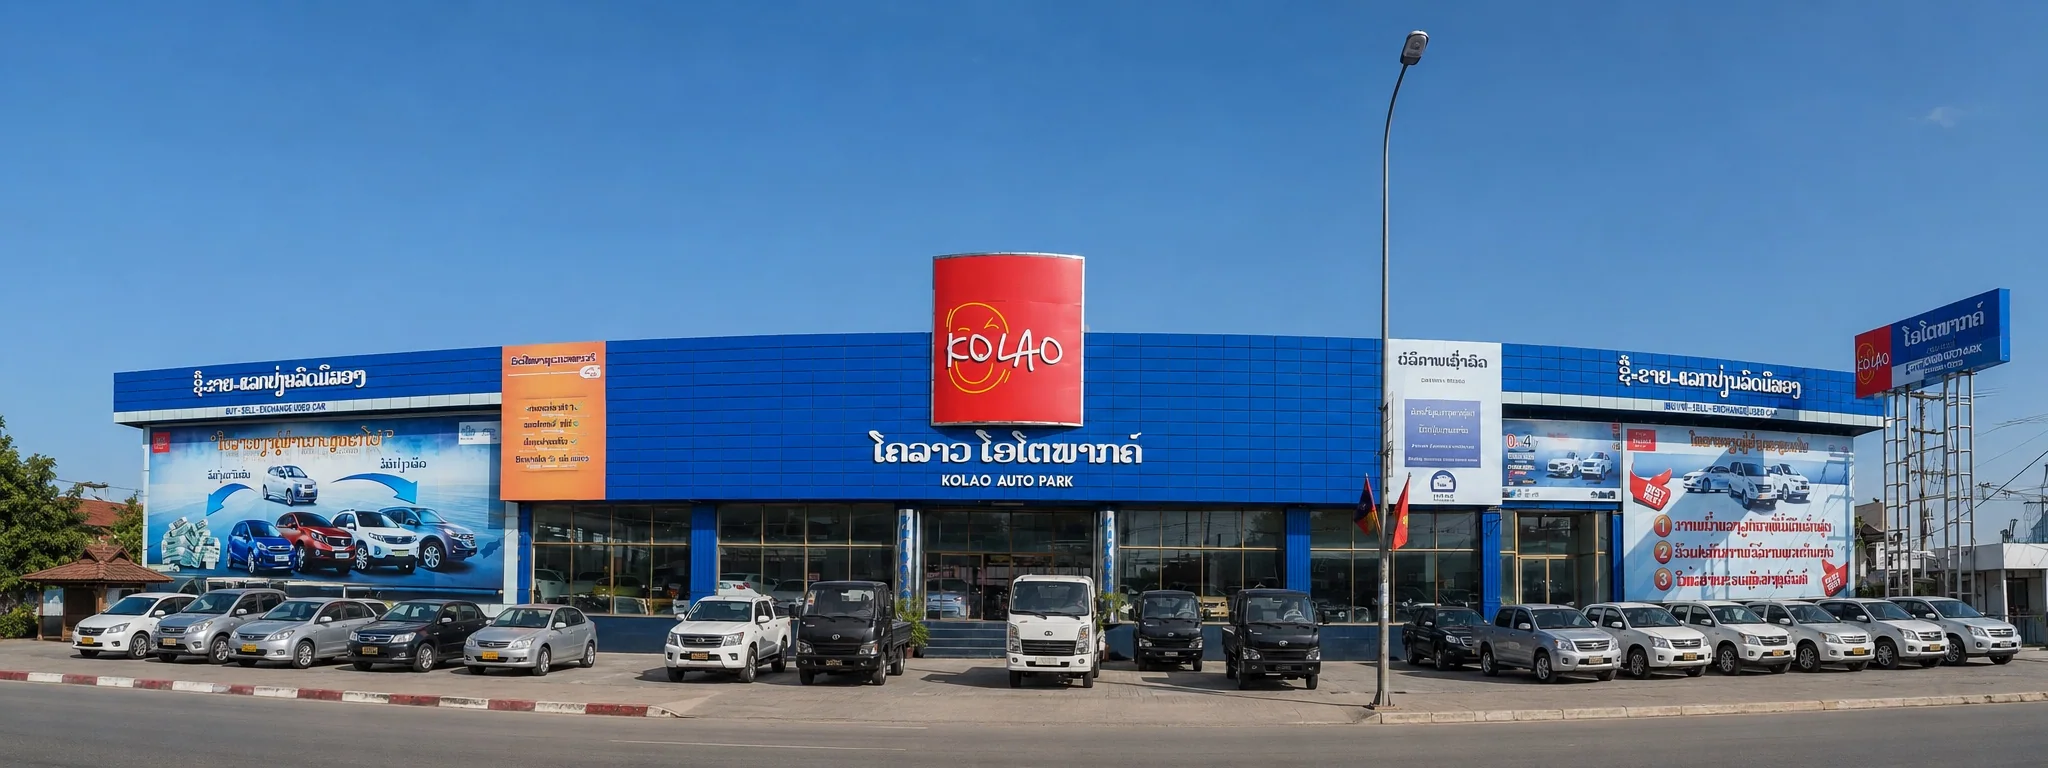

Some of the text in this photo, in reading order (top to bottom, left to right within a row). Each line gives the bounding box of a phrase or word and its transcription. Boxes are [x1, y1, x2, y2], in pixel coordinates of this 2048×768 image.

[946, 328, 1063, 372] KOLAO
[1857, 348, 1890, 373] KOLAO
[942, 474, 1073, 488] KOLAO AUTO PARK
[1658, 518, 1665, 533] 1
[1659, 545, 1668, 559] 2
[1659, 572, 1667, 586] 3
